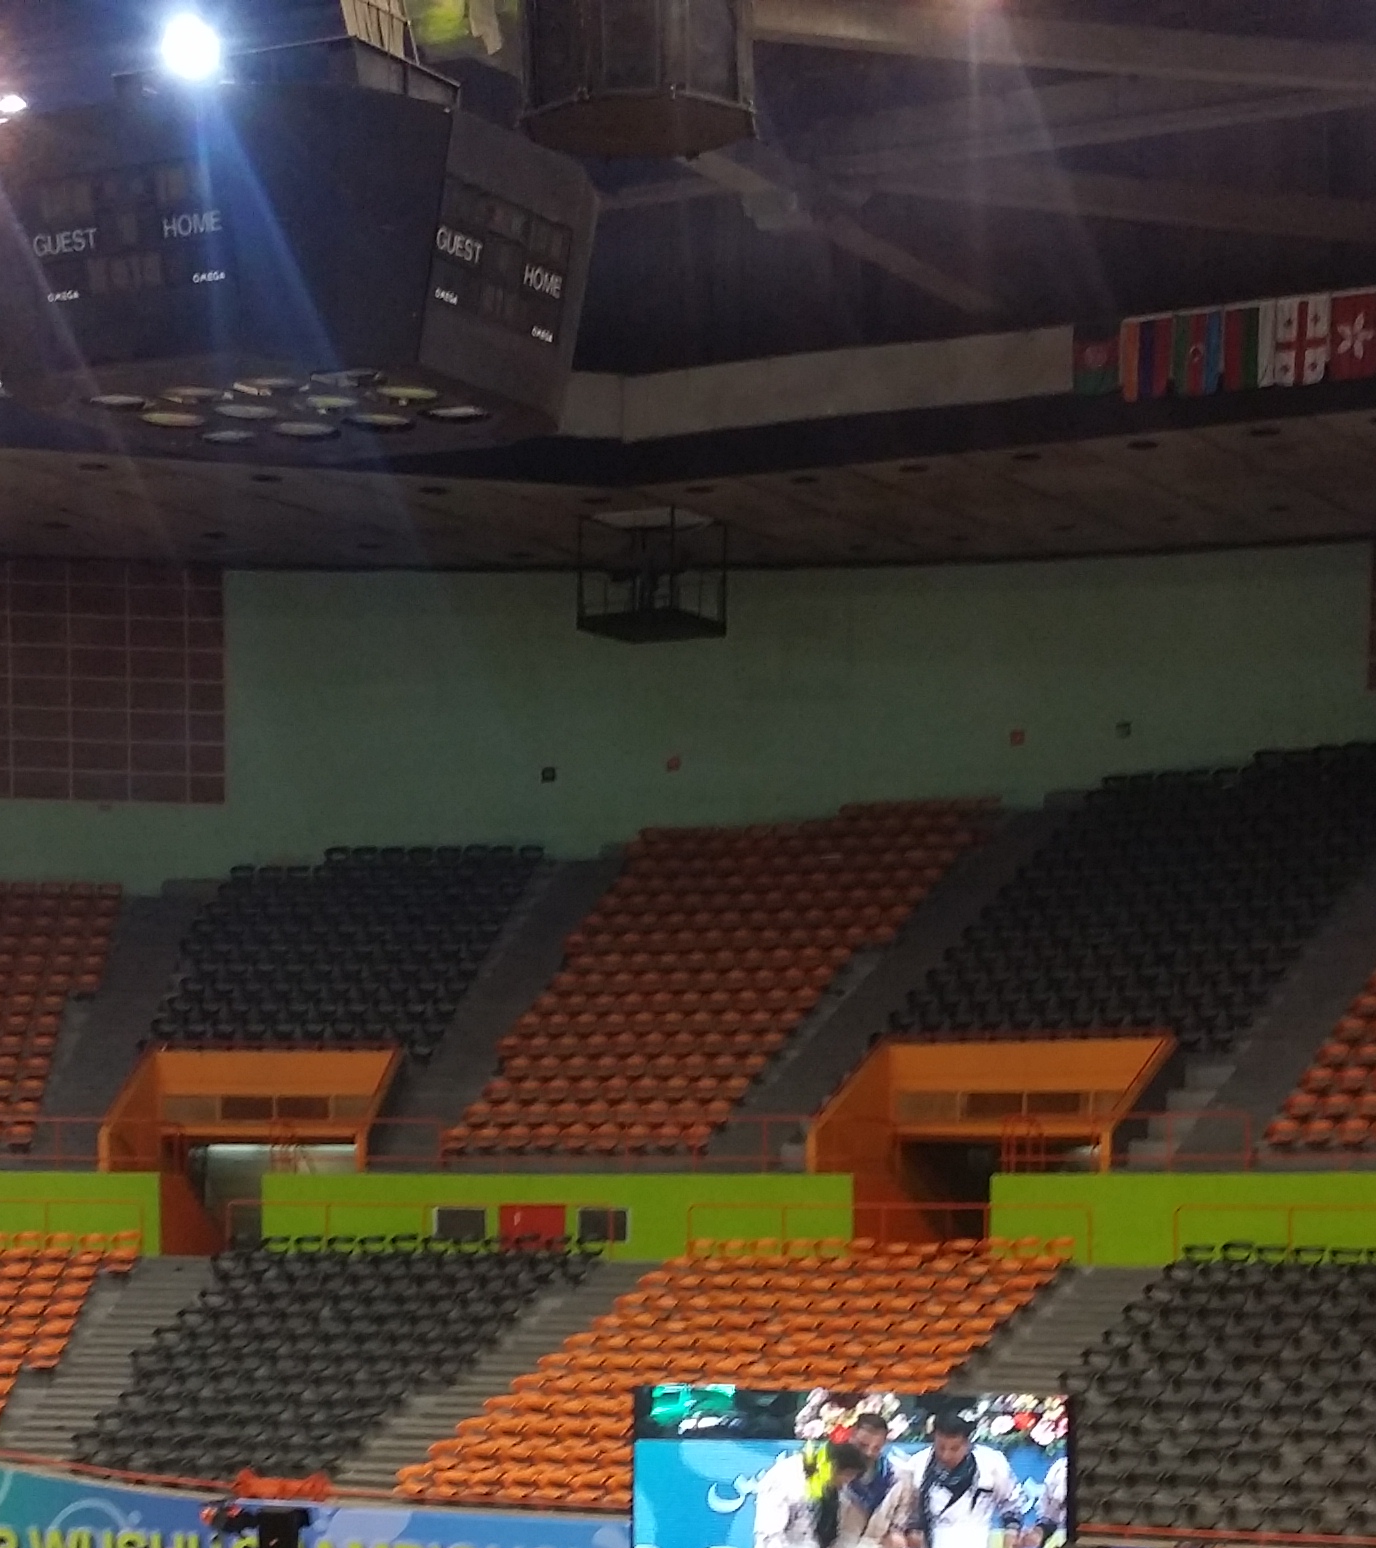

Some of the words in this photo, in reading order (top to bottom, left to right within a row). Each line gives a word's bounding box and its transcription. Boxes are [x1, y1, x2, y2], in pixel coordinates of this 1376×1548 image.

[163, 210, 222, 238] HOME
[33, 228, 97, 257] GUEST
[436, 226, 483, 263] GUEST
[192, 270, 225, 283] OMEGA
[523, 263, 562, 299] HOME
